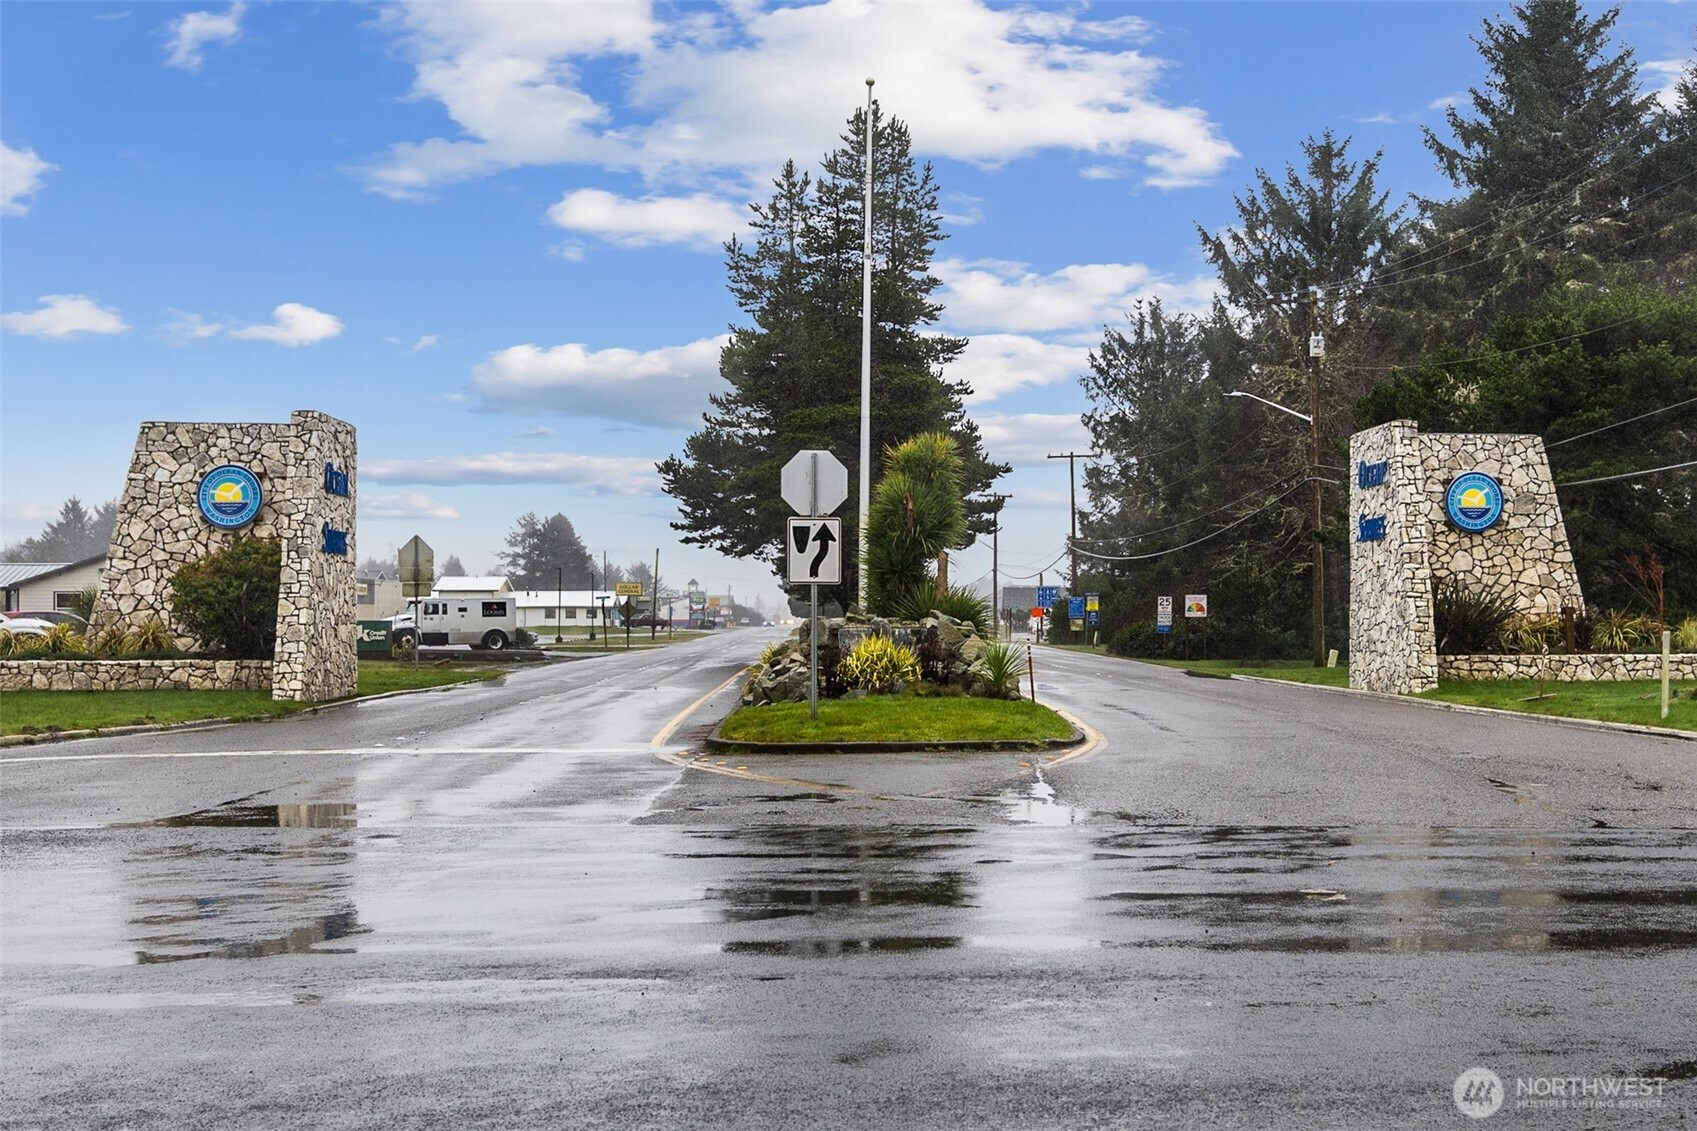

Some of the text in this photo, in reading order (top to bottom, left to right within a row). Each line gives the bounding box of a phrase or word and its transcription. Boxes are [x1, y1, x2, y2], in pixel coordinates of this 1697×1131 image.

[207, 474, 216, 484] OF
[243, 474, 258, 501] SHORES
[1449, 490, 1457, 506] CITY
[1455, 481, 1463, 489] OF
[1487, 480, 1500, 506] SHORES
[205, 508, 255, 524] WASHINGTON
[1453, 512, 1496, 528] WASHINGTON
[1159, 598, 1171, 606] 25
